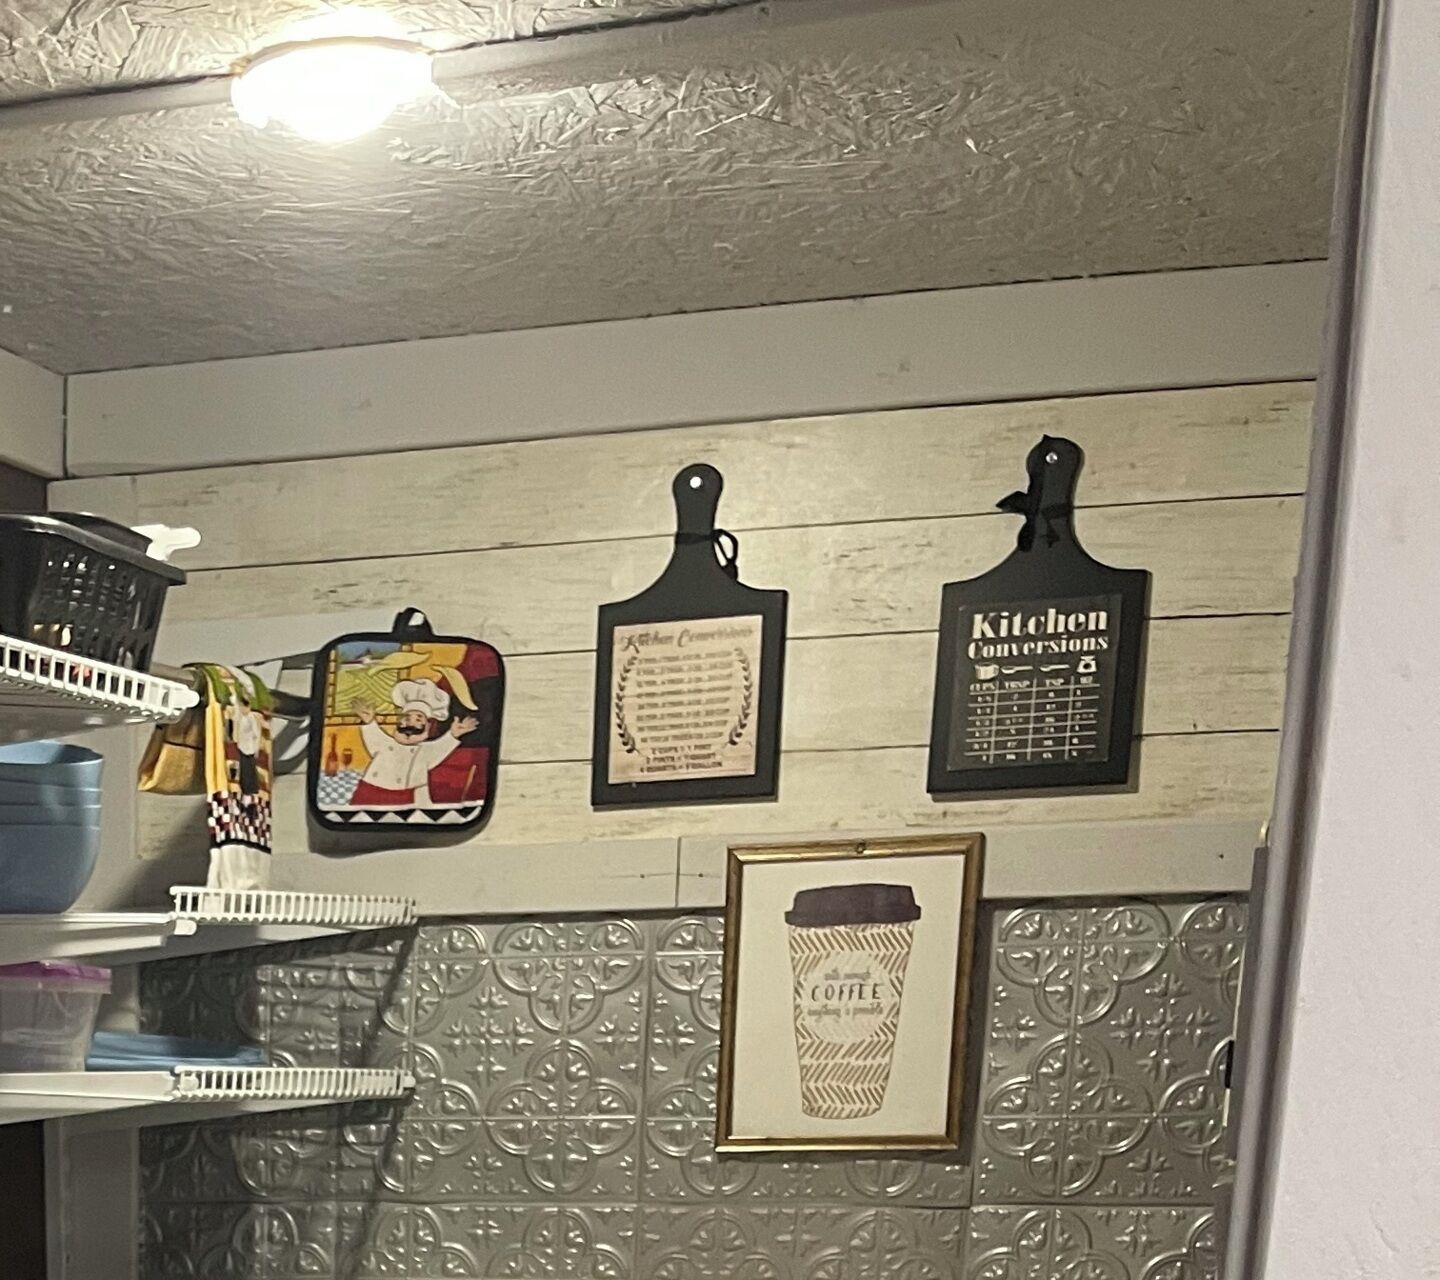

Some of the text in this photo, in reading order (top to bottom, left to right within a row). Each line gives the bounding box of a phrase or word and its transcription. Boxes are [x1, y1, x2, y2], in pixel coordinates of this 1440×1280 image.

[972, 608, 1108, 639] Kitchen
[968, 634, 1109, 659] Conversions
[811, 983, 884, 1001] COFFEE
